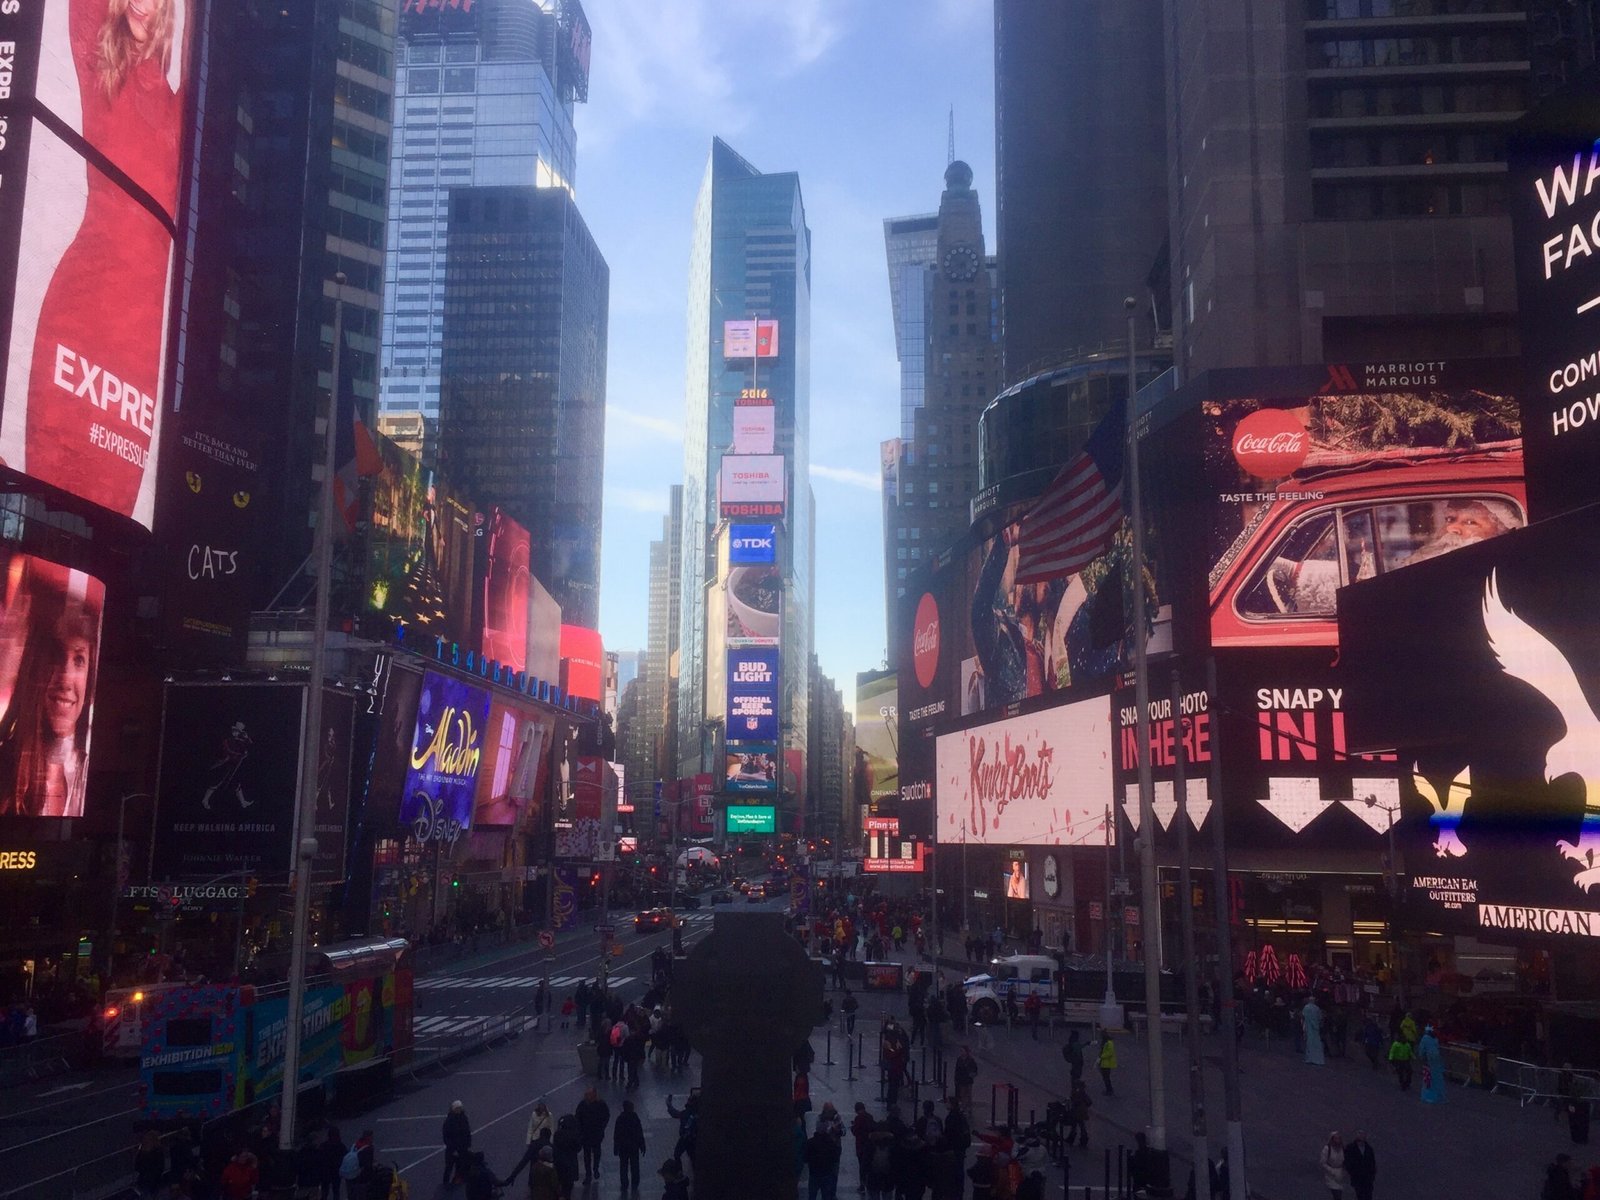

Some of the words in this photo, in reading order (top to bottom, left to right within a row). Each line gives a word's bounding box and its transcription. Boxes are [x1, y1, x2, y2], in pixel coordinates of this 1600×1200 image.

[1366, 362, 1446, 374] MARRIOTT
[1549, 350, 1600, 393] COM
[1367, 375, 1438, 387] MARQUIS
[741, 389, 768, 399] 2016
[182, 435, 212, 456] BETTER
[214, 448, 235, 464] THAN
[212, 437, 231, 452] BACK
[232, 447, 249, 459] AND
[1236, 432, 1304, 455] Coca-Cola
[1220, 493, 1253, 503] TASTE
[1255, 492, 1276, 502] THE
[1279, 491, 1324, 501] FEELING
[722, 504, 783, 515] TOSHIBA
[742, 538, 772, 548] TDK
[188, 544, 239, 580] CATS
[437, 637, 488, 677] 1540
[492, 660, 581, 712] BROADWAY
[734, 672, 772, 682] LIGHT
[738, 662, 767, 672] BUD
[1257, 688, 1323, 709] SNAP
[732, 708, 773, 716] SPONSOR
[909, 708, 921, 721] TASTE
[928, 700, 945, 716] FEELING
[1120, 706, 1138, 726] SNA
[412, 706, 480, 778] Aladdin
[1258, 712, 1317, 761] IN
[901, 780, 927, 801] swatch
[970, 735, 1010, 837] Kinky
[1010, 740, 1054, 800] Boots
[174, 823, 195, 832] KEEP
[198, 823, 236, 833] WALKING
[238, 823, 276, 833] AMERICA
[1413, 877, 1461, 890] AMERICAN
[1429, 890, 1476, 903] OUTFITTERS
[1444, 902, 1463, 910] ae.com
[1482, 906, 1592, 936] AMERICAN
[142, 1041, 234, 1069] EXHIBITIONISM
